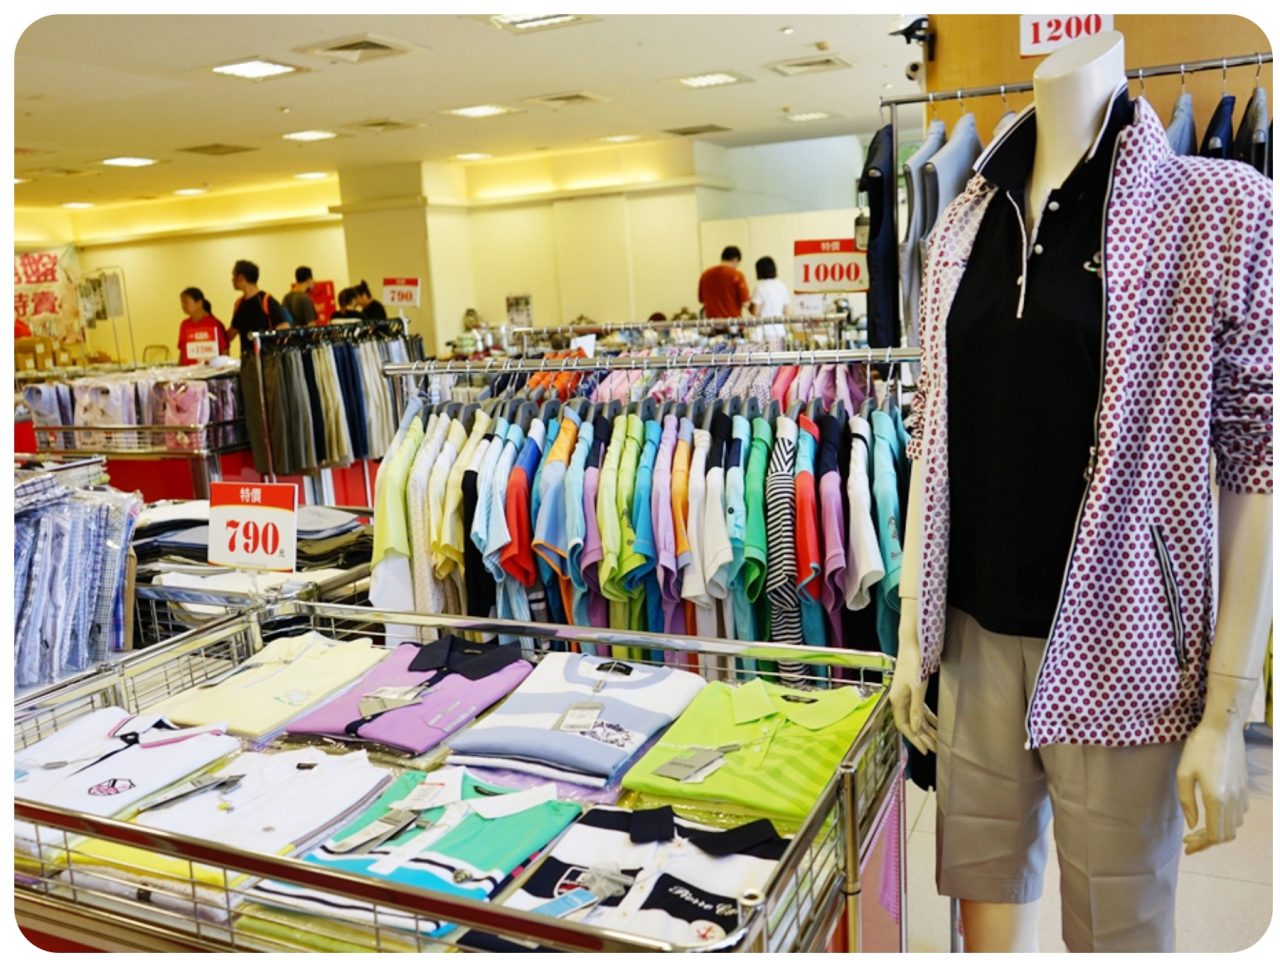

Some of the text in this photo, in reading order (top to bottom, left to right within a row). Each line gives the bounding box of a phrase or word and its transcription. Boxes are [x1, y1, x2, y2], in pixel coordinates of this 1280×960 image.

[1031, 13, 1102, 45] 1200
[803, 263, 860, 283] 1000
[240, 487, 262, 503] 特價
[226, 520, 279, 555] 790
